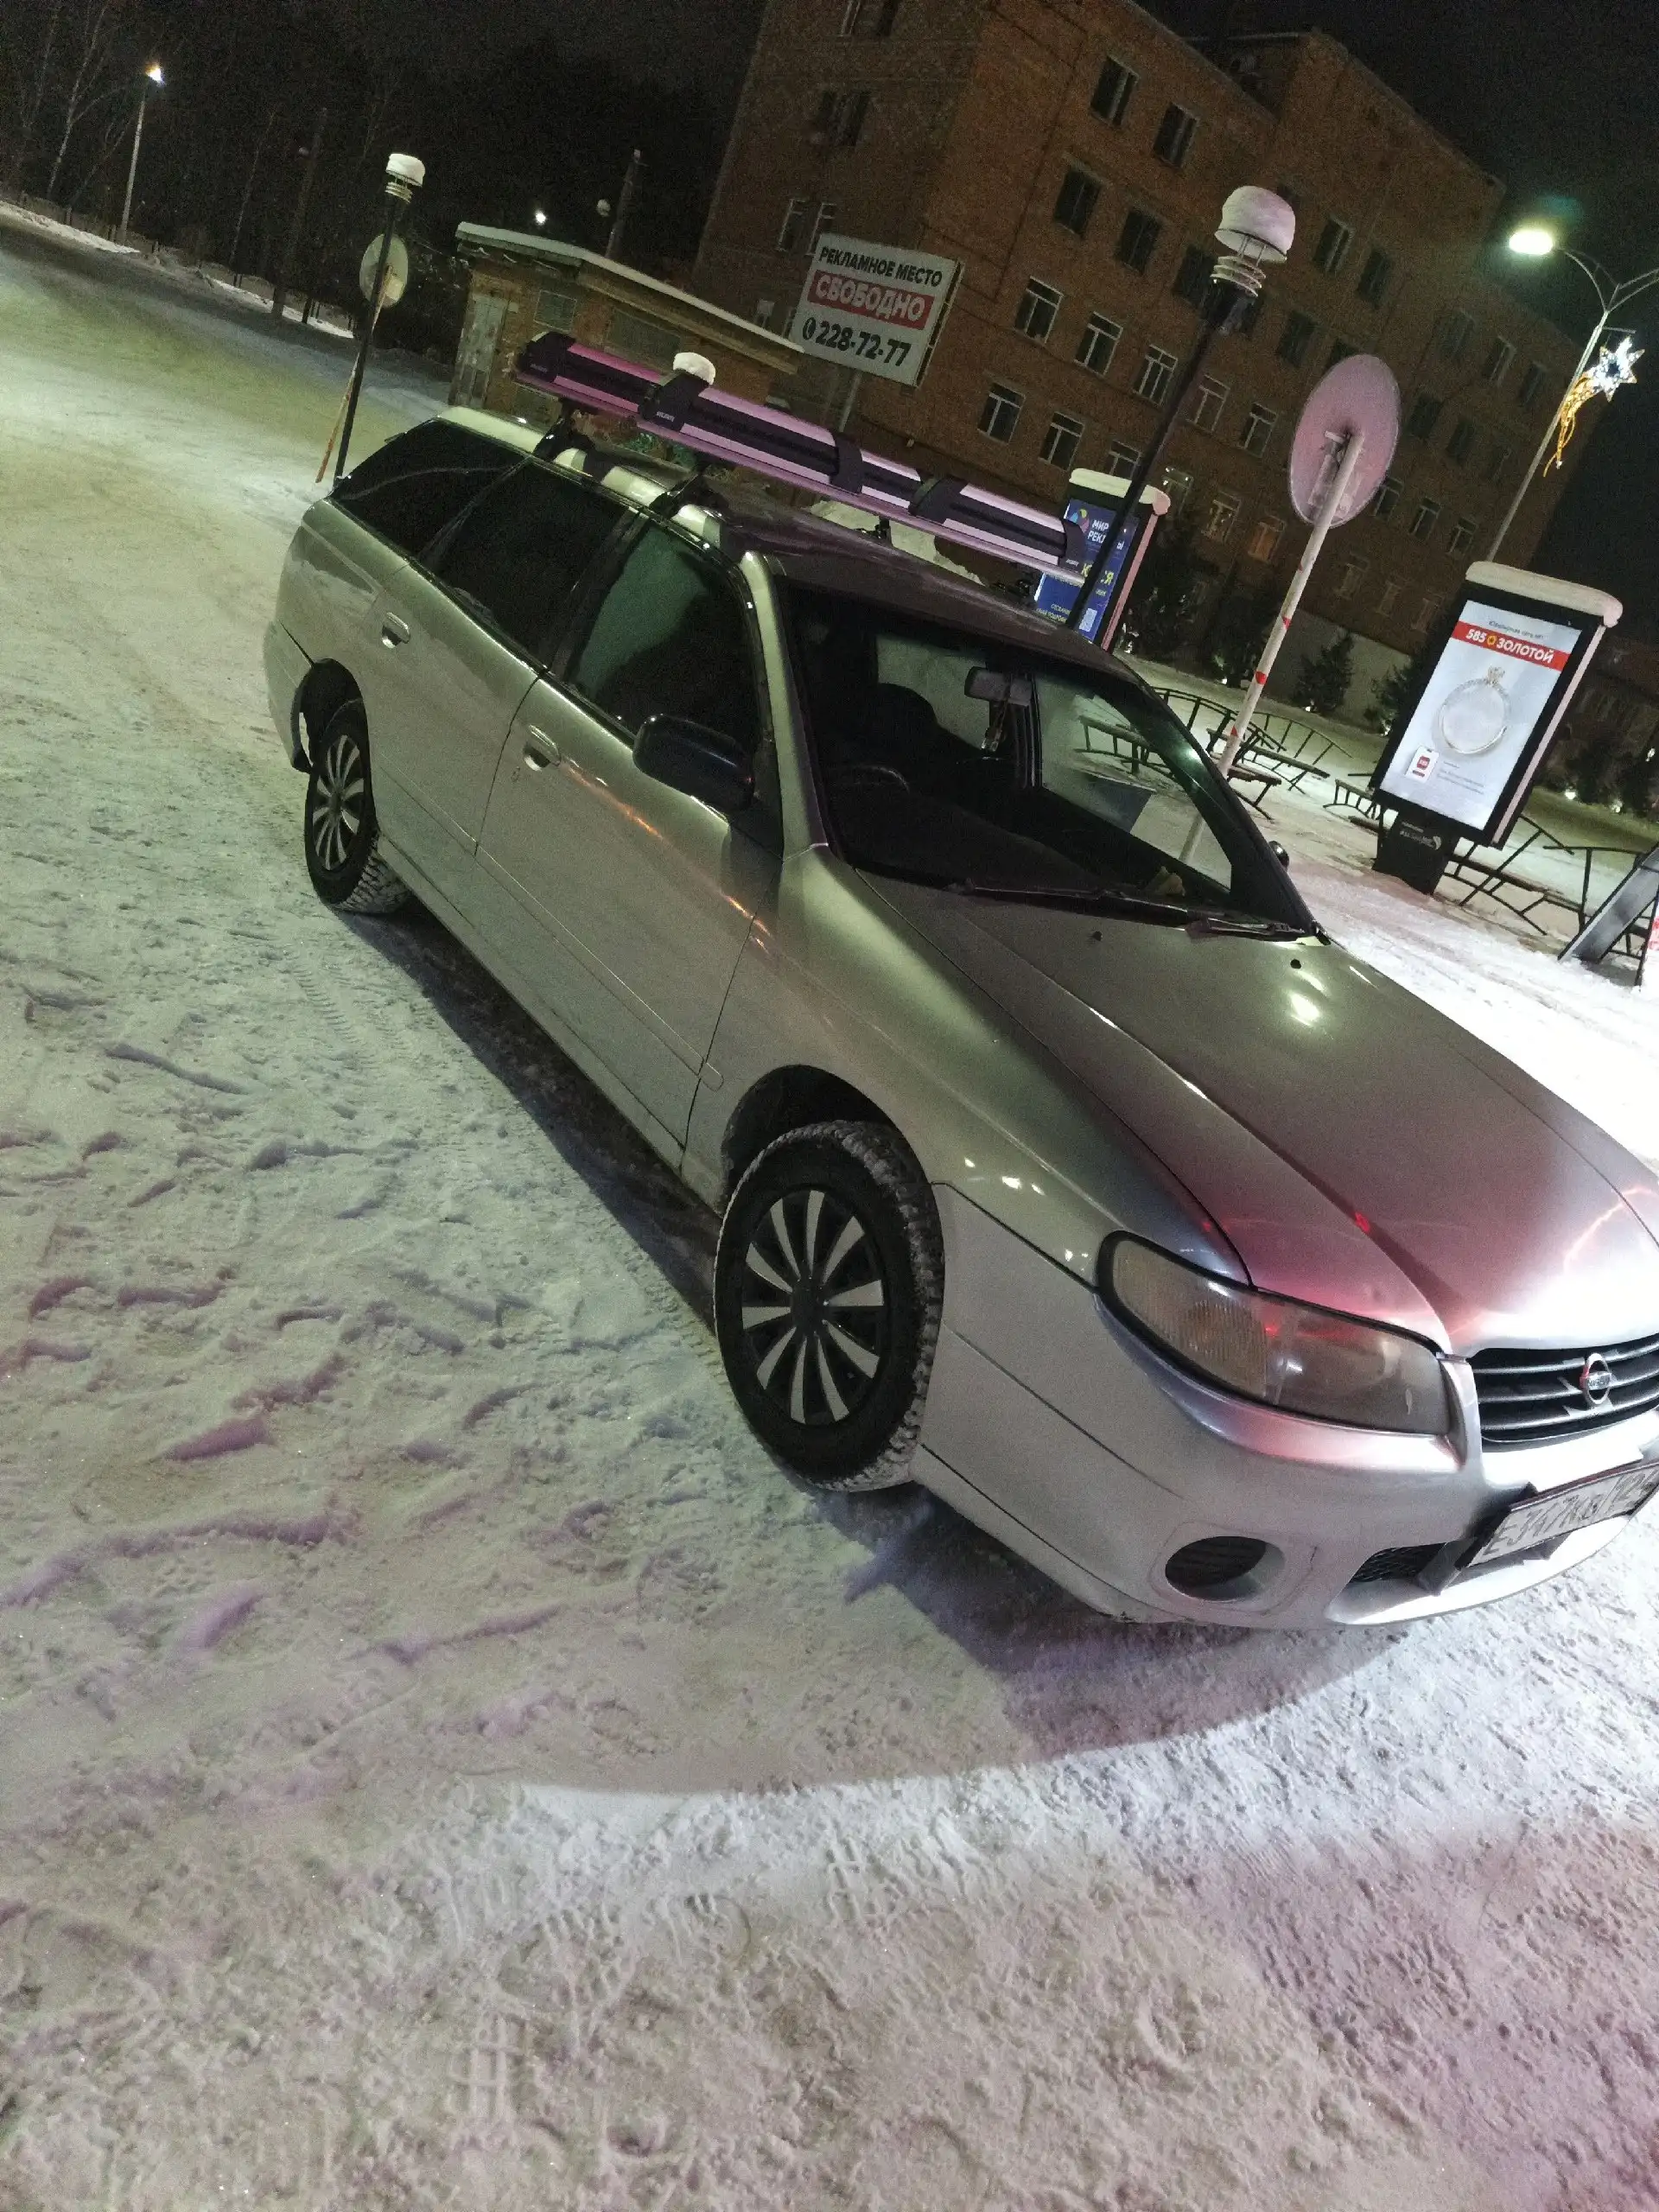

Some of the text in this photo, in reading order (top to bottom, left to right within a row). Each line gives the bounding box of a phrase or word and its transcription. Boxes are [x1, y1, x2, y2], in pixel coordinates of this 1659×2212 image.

[821, 246, 942, 287] РЕКЛАМНОЕ МЕСТО
[816, 274, 925, 321] СВОБОДНО
[1091, 519, 1109, 531] МИР
[1465, 628, 1554, 664] 585 ЗОЛОТОЙ
